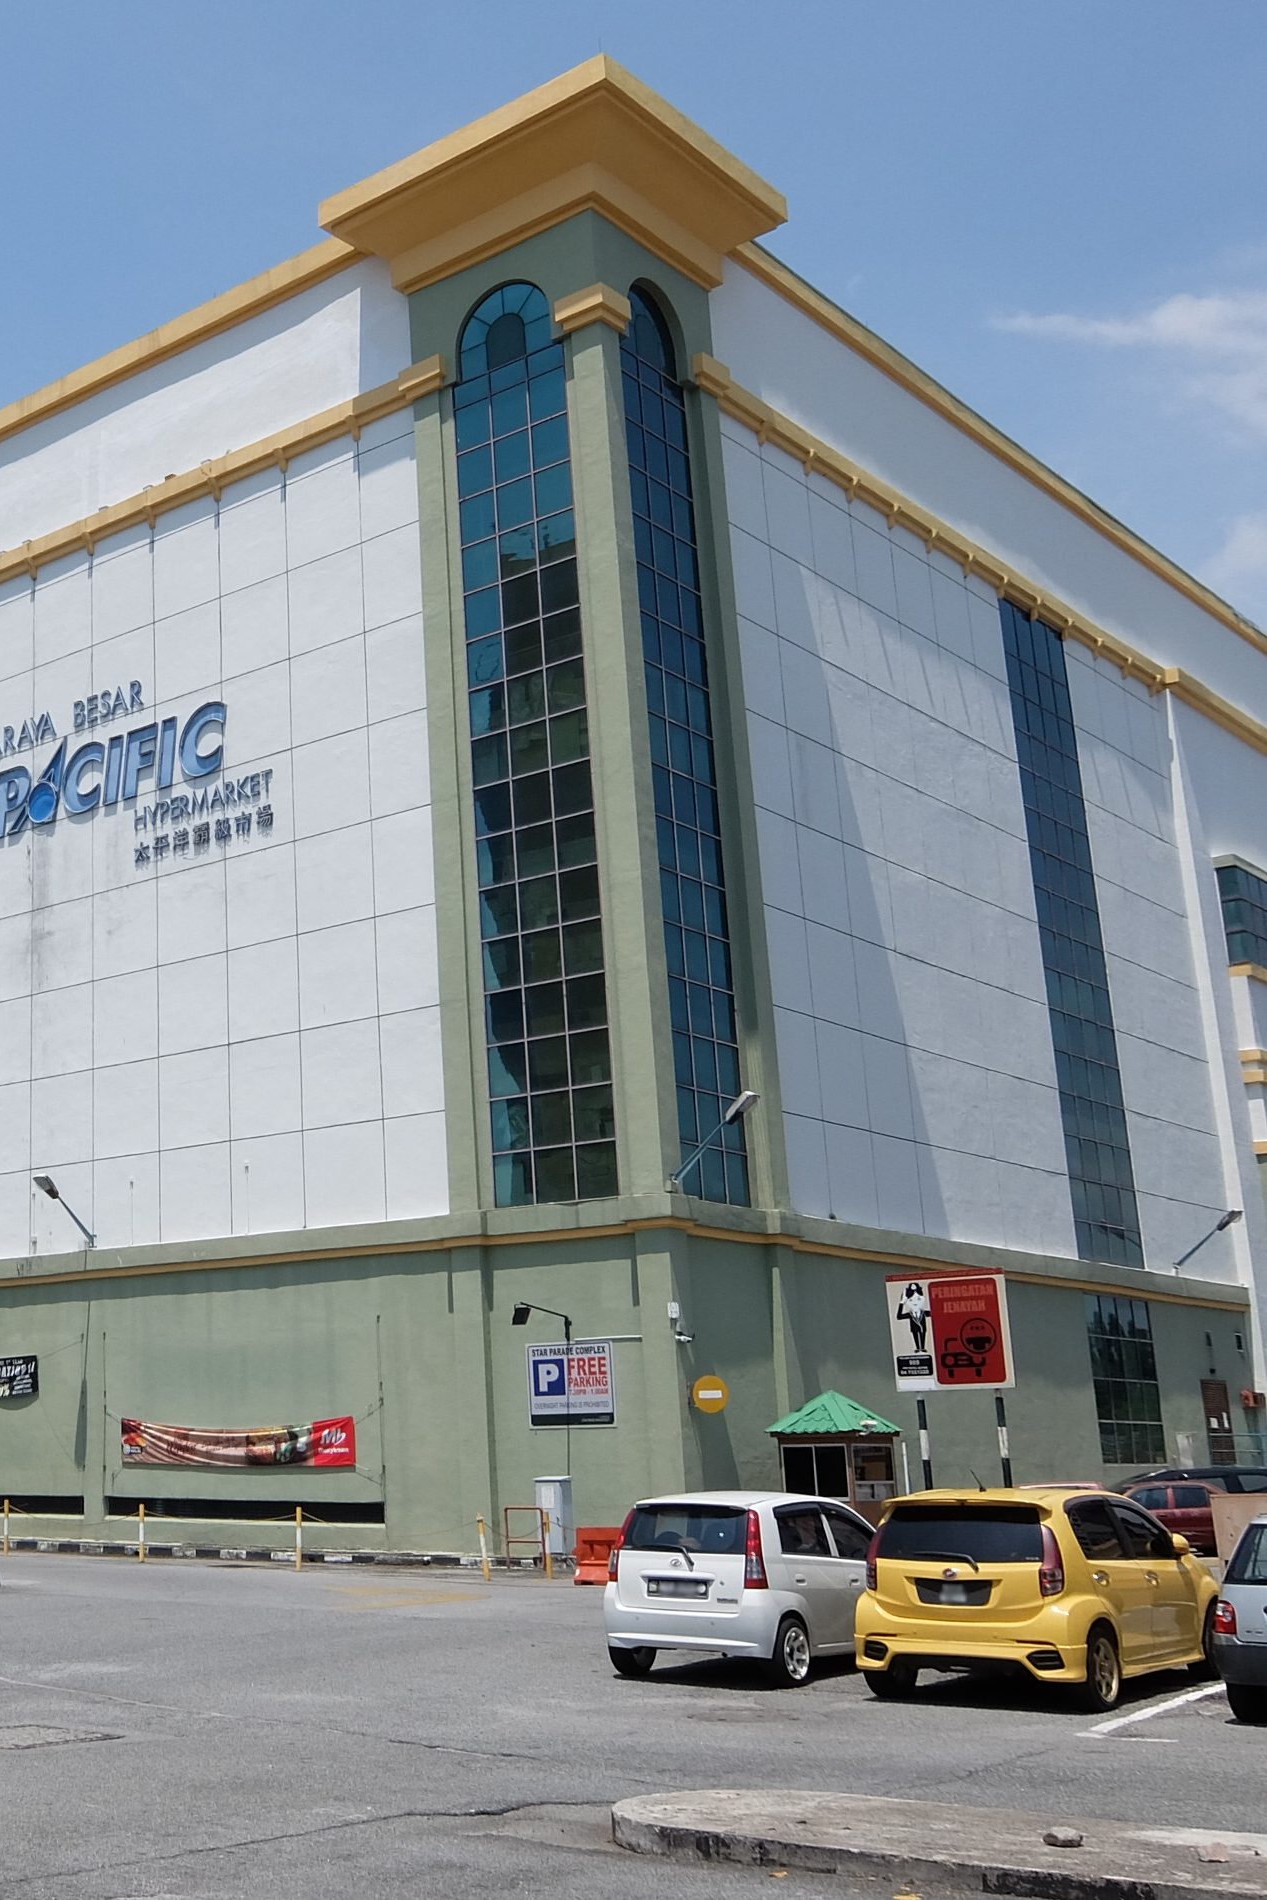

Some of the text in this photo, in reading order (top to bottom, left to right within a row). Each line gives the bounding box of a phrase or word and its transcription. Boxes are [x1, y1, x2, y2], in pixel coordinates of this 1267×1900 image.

[73, 679, 144, 728] BESAR
[134, 768, 273, 832] HYPERMARKET
[931, 1284, 994, 1298] PERINGATAN
[943, 1300, 986, 1313] JENAYAH
[531, 1345, 606, 1357] STAR PARADE COMPLEX
[567, 1357, 607, 1376] FREE
[538, 1363, 559, 1392] P
[568, 1376, 608, 1388] PARKING
